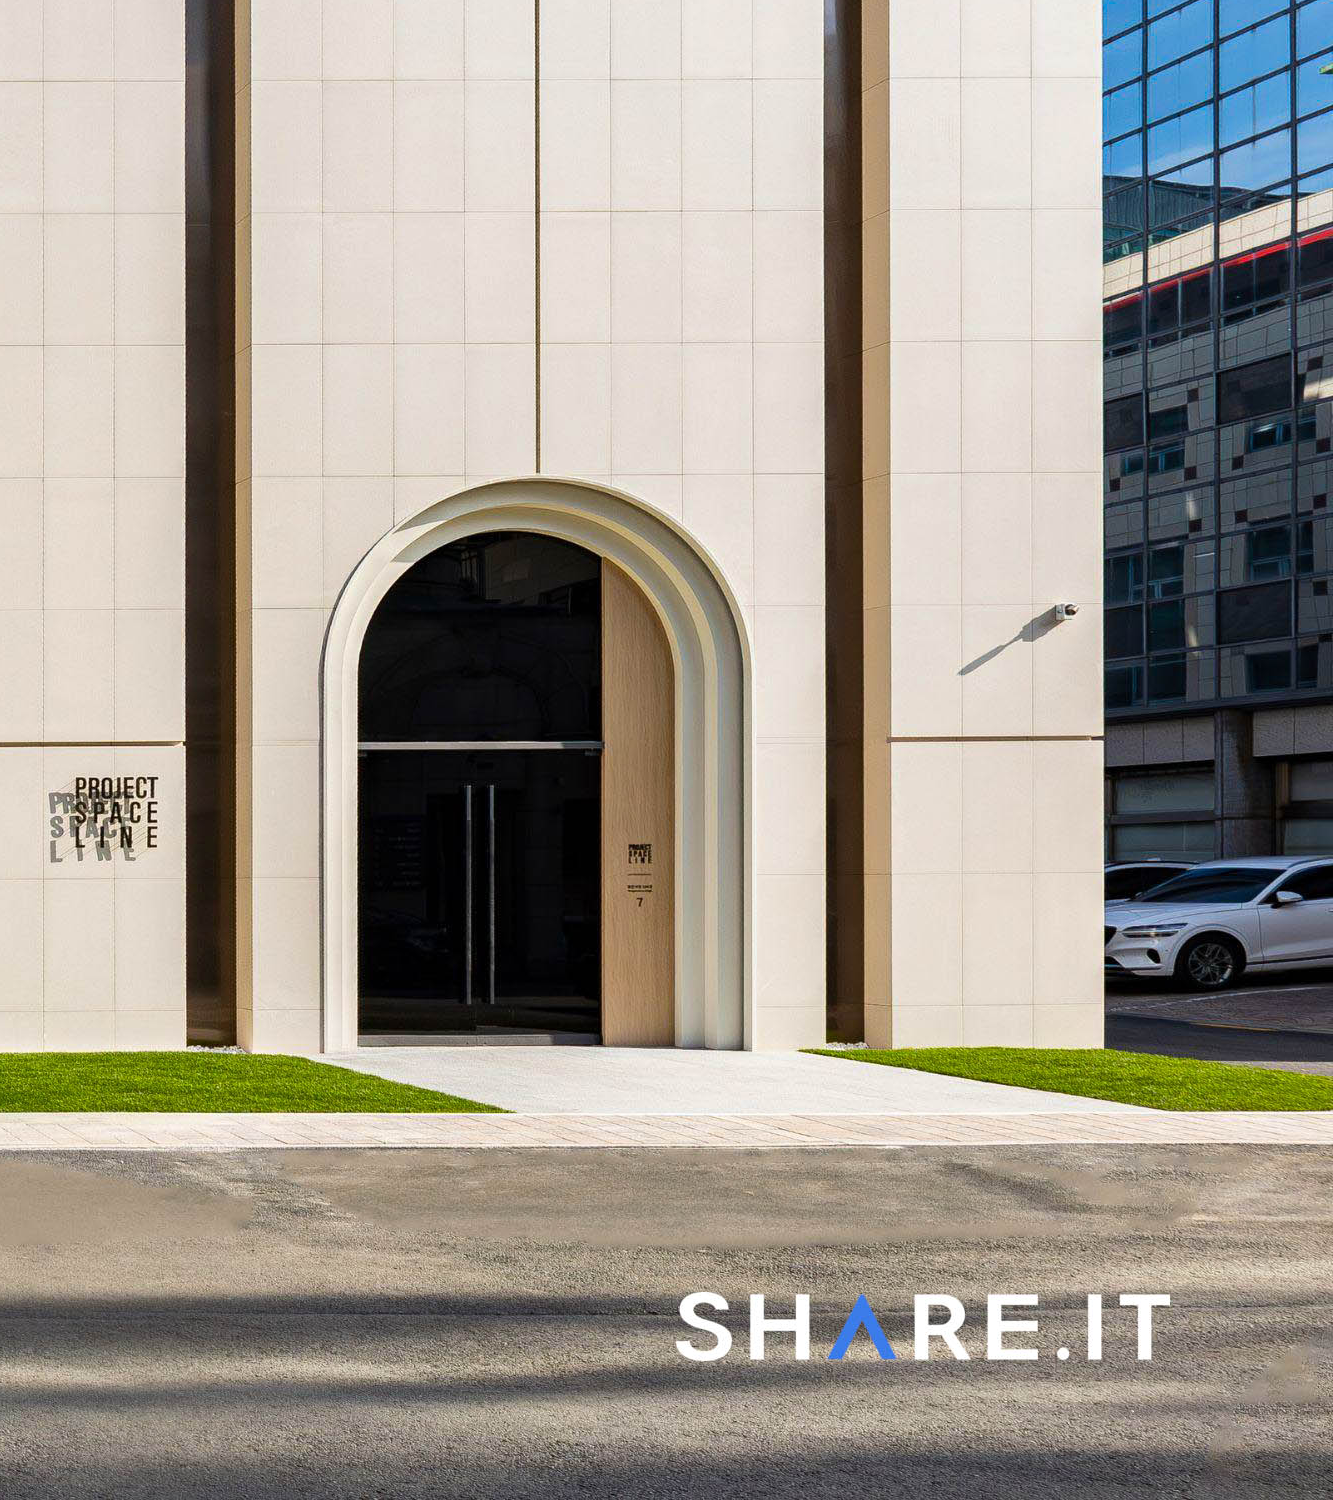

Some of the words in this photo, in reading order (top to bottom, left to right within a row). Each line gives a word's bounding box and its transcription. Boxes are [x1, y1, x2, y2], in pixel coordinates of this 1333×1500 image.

[75, 776, 159, 799] PROJECT
[74, 801, 158, 824] SPACE
[75, 825, 158, 848] LINE
[636, 897, 644, 907] 7
